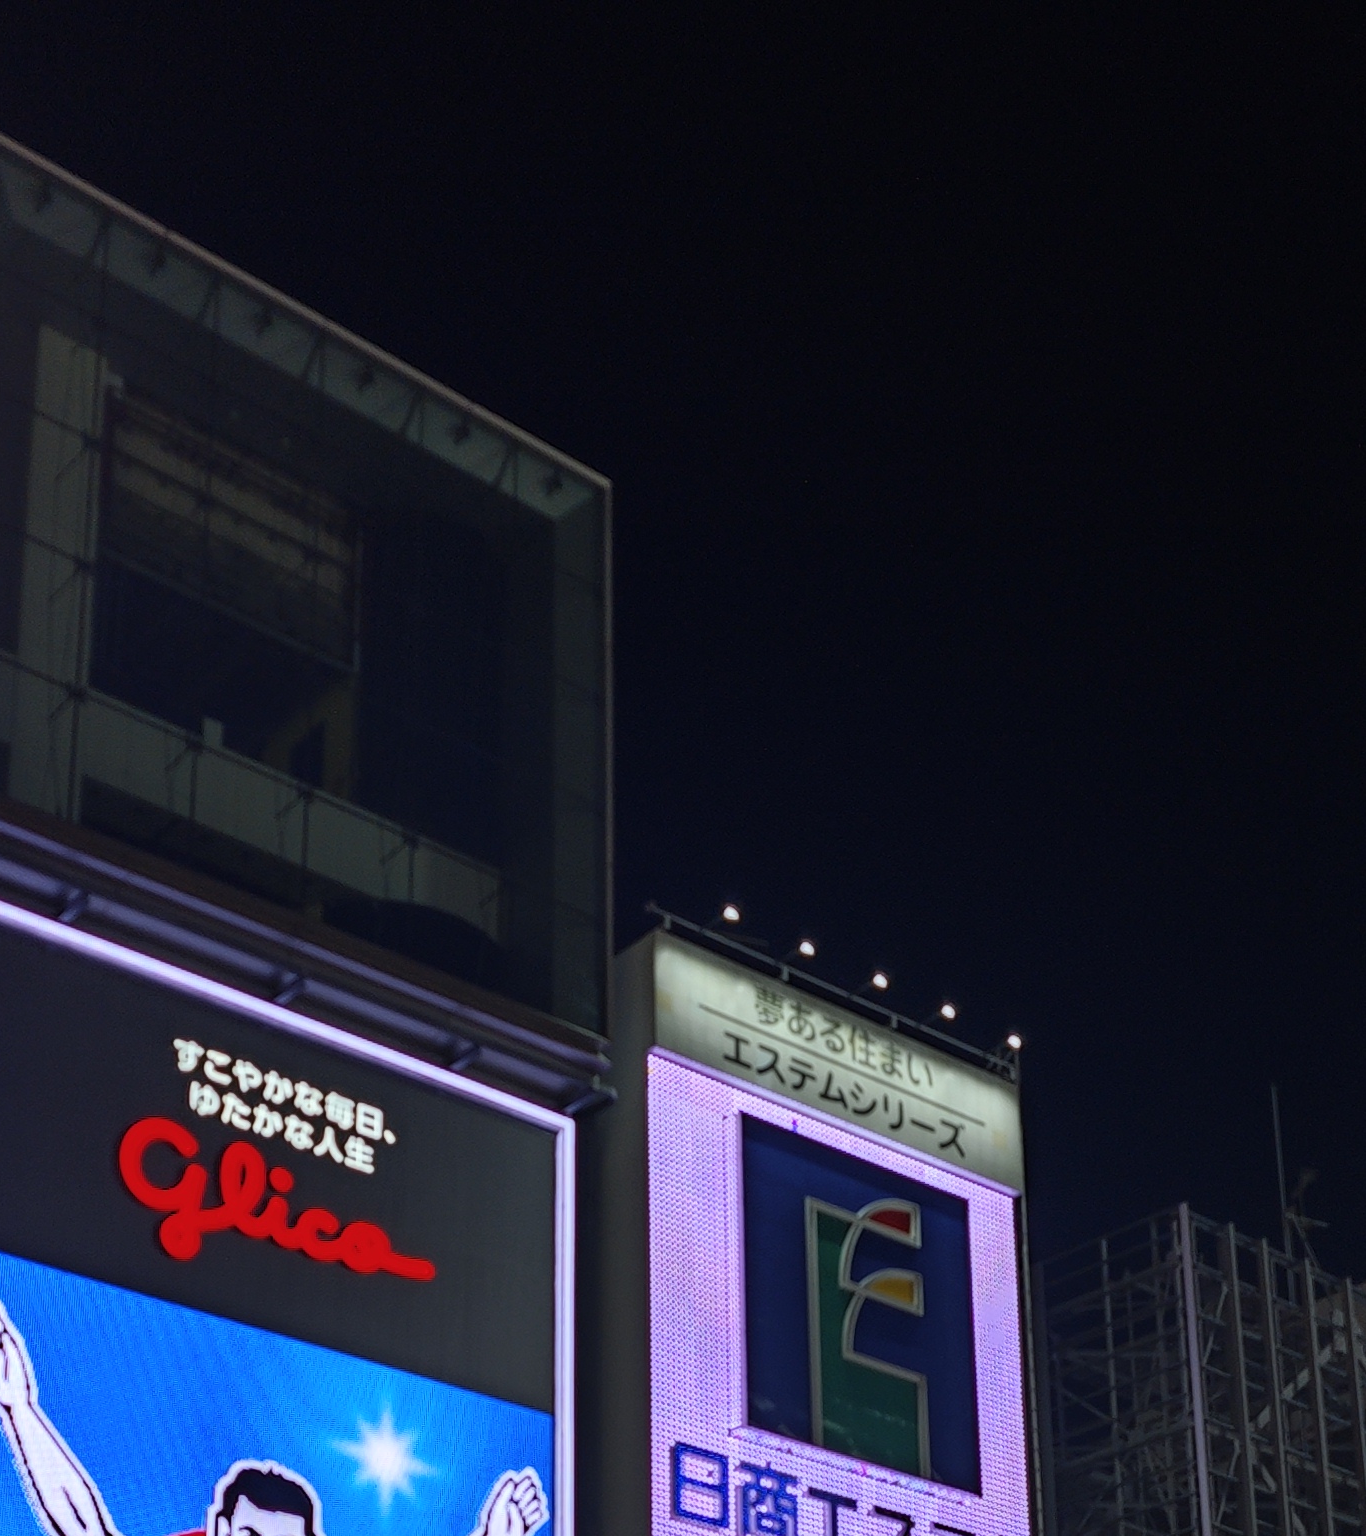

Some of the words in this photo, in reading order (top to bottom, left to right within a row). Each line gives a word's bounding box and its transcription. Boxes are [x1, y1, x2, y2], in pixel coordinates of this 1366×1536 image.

[754, 984, 935, 1090] 夢ある住まい
[172, 1038, 398, 1145] すこやかな毎日、
[188, 1080, 376, 1175] ゆたかな人生
[722, 1030, 968, 1158] エステムシリーズ
